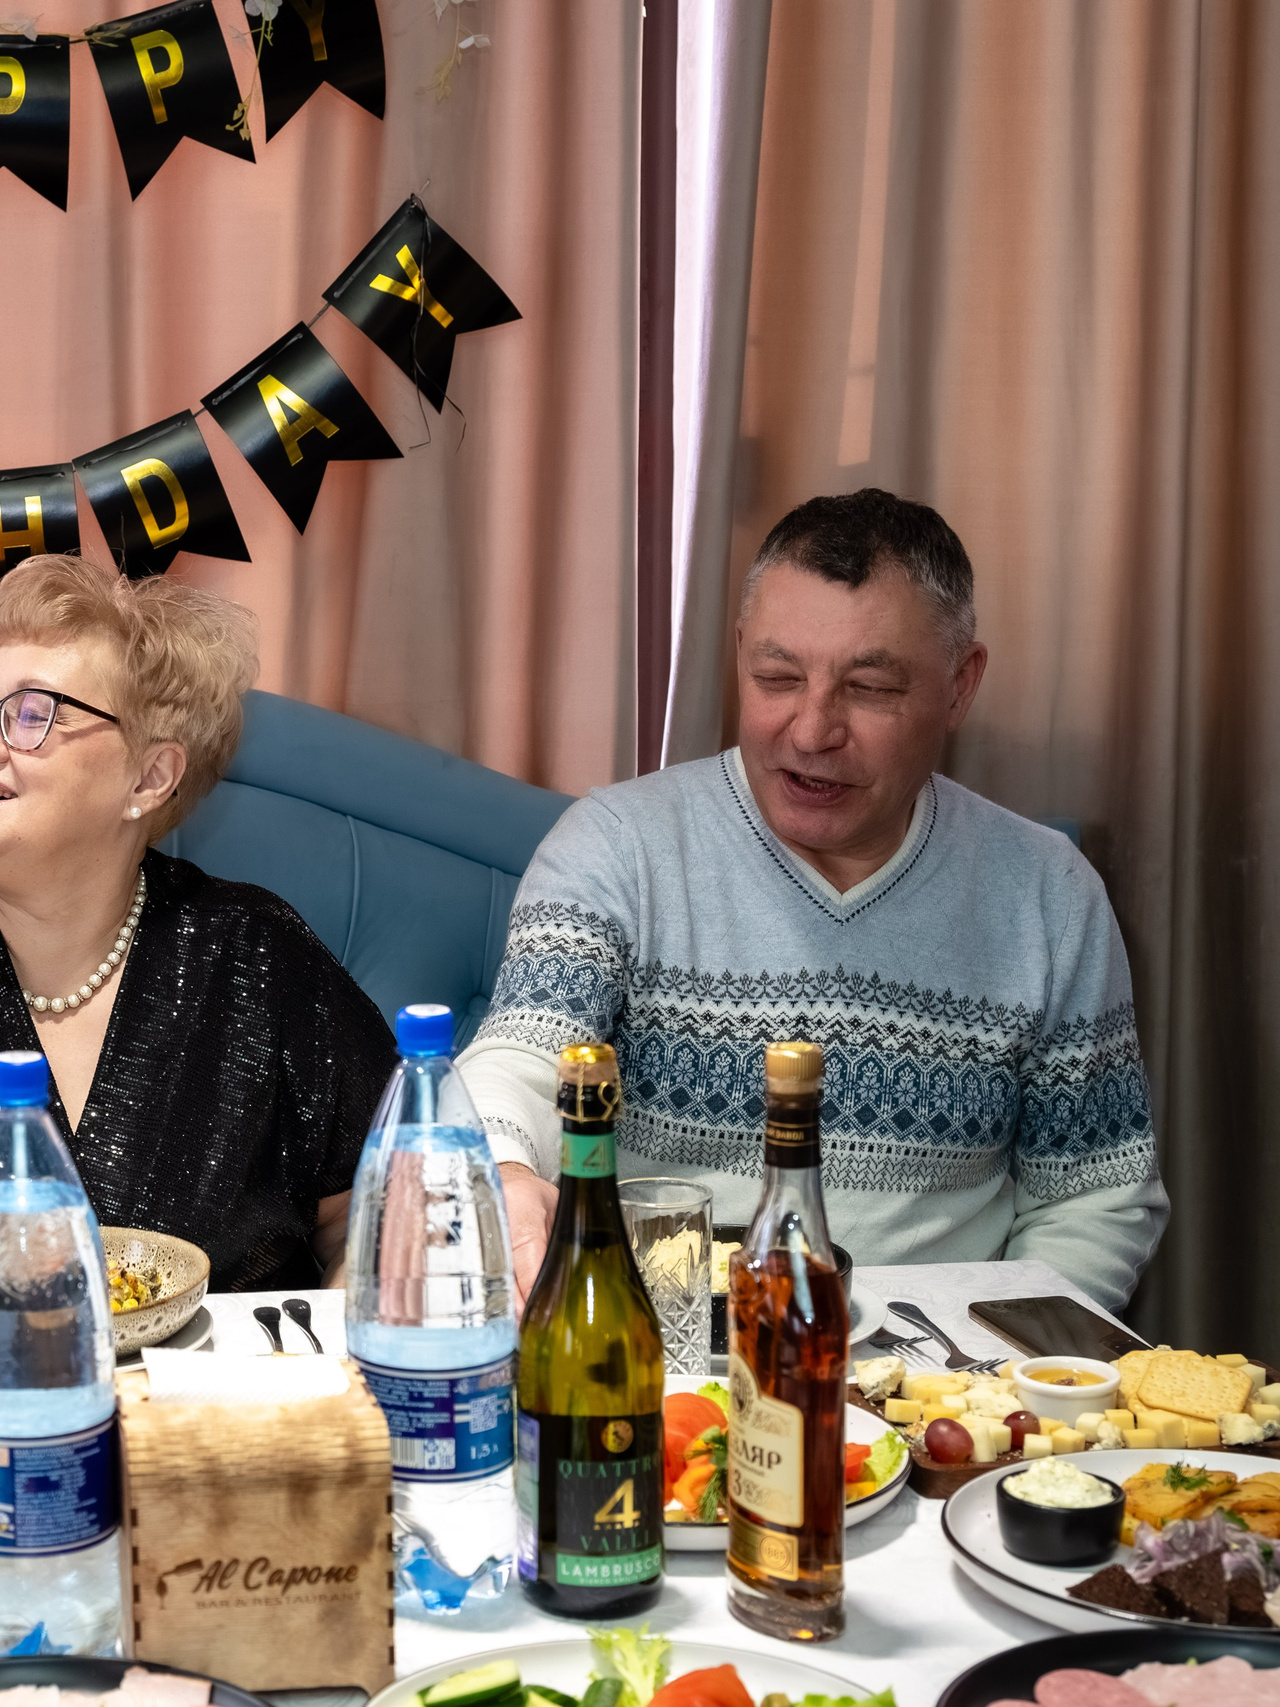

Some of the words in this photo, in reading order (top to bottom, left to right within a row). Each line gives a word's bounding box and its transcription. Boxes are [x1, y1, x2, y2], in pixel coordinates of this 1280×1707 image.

[733, 1434, 782, 1470] ЗЛЯР
[558, 1453, 662, 1480] QUATTRO
[593, 1477, 642, 1530] 4
[579, 1530, 651, 1553] VALLI
[192, 1557, 240, 1594] Al
[243, 1556, 360, 1598] Capone
[560, 1552, 661, 1578] LAMBRUSCO
[196, 1599, 230, 1610] BAR
[235, 1598, 248, 1608] &
[251, 1591, 362, 1607] RESTAURANT
